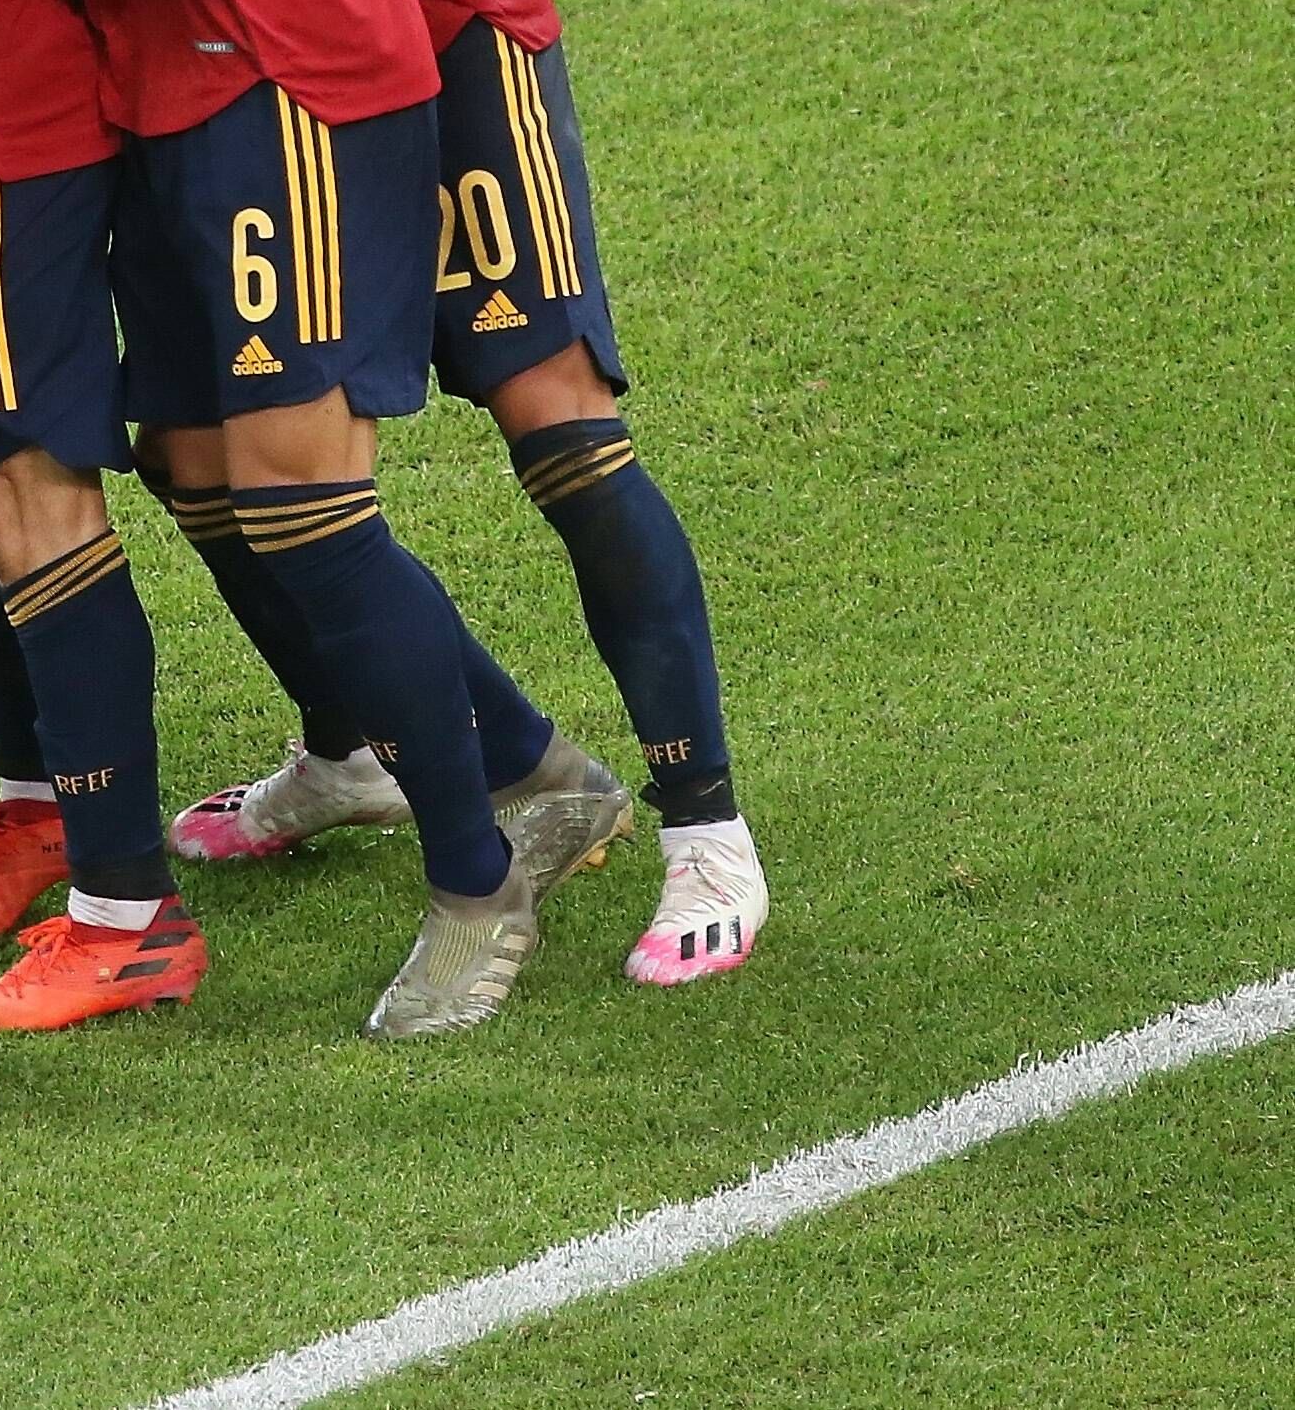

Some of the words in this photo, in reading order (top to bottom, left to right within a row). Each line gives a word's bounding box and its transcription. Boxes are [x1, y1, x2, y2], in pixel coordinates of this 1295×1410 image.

[436, 170, 517, 293] 20
[233, 207, 278, 323] 6
[472, 313, 530, 333] adidas
[232, 361, 284, 377] adidas
[642, 738, 691, 765] RFEF
[54, 767, 114, 796] RFEF
